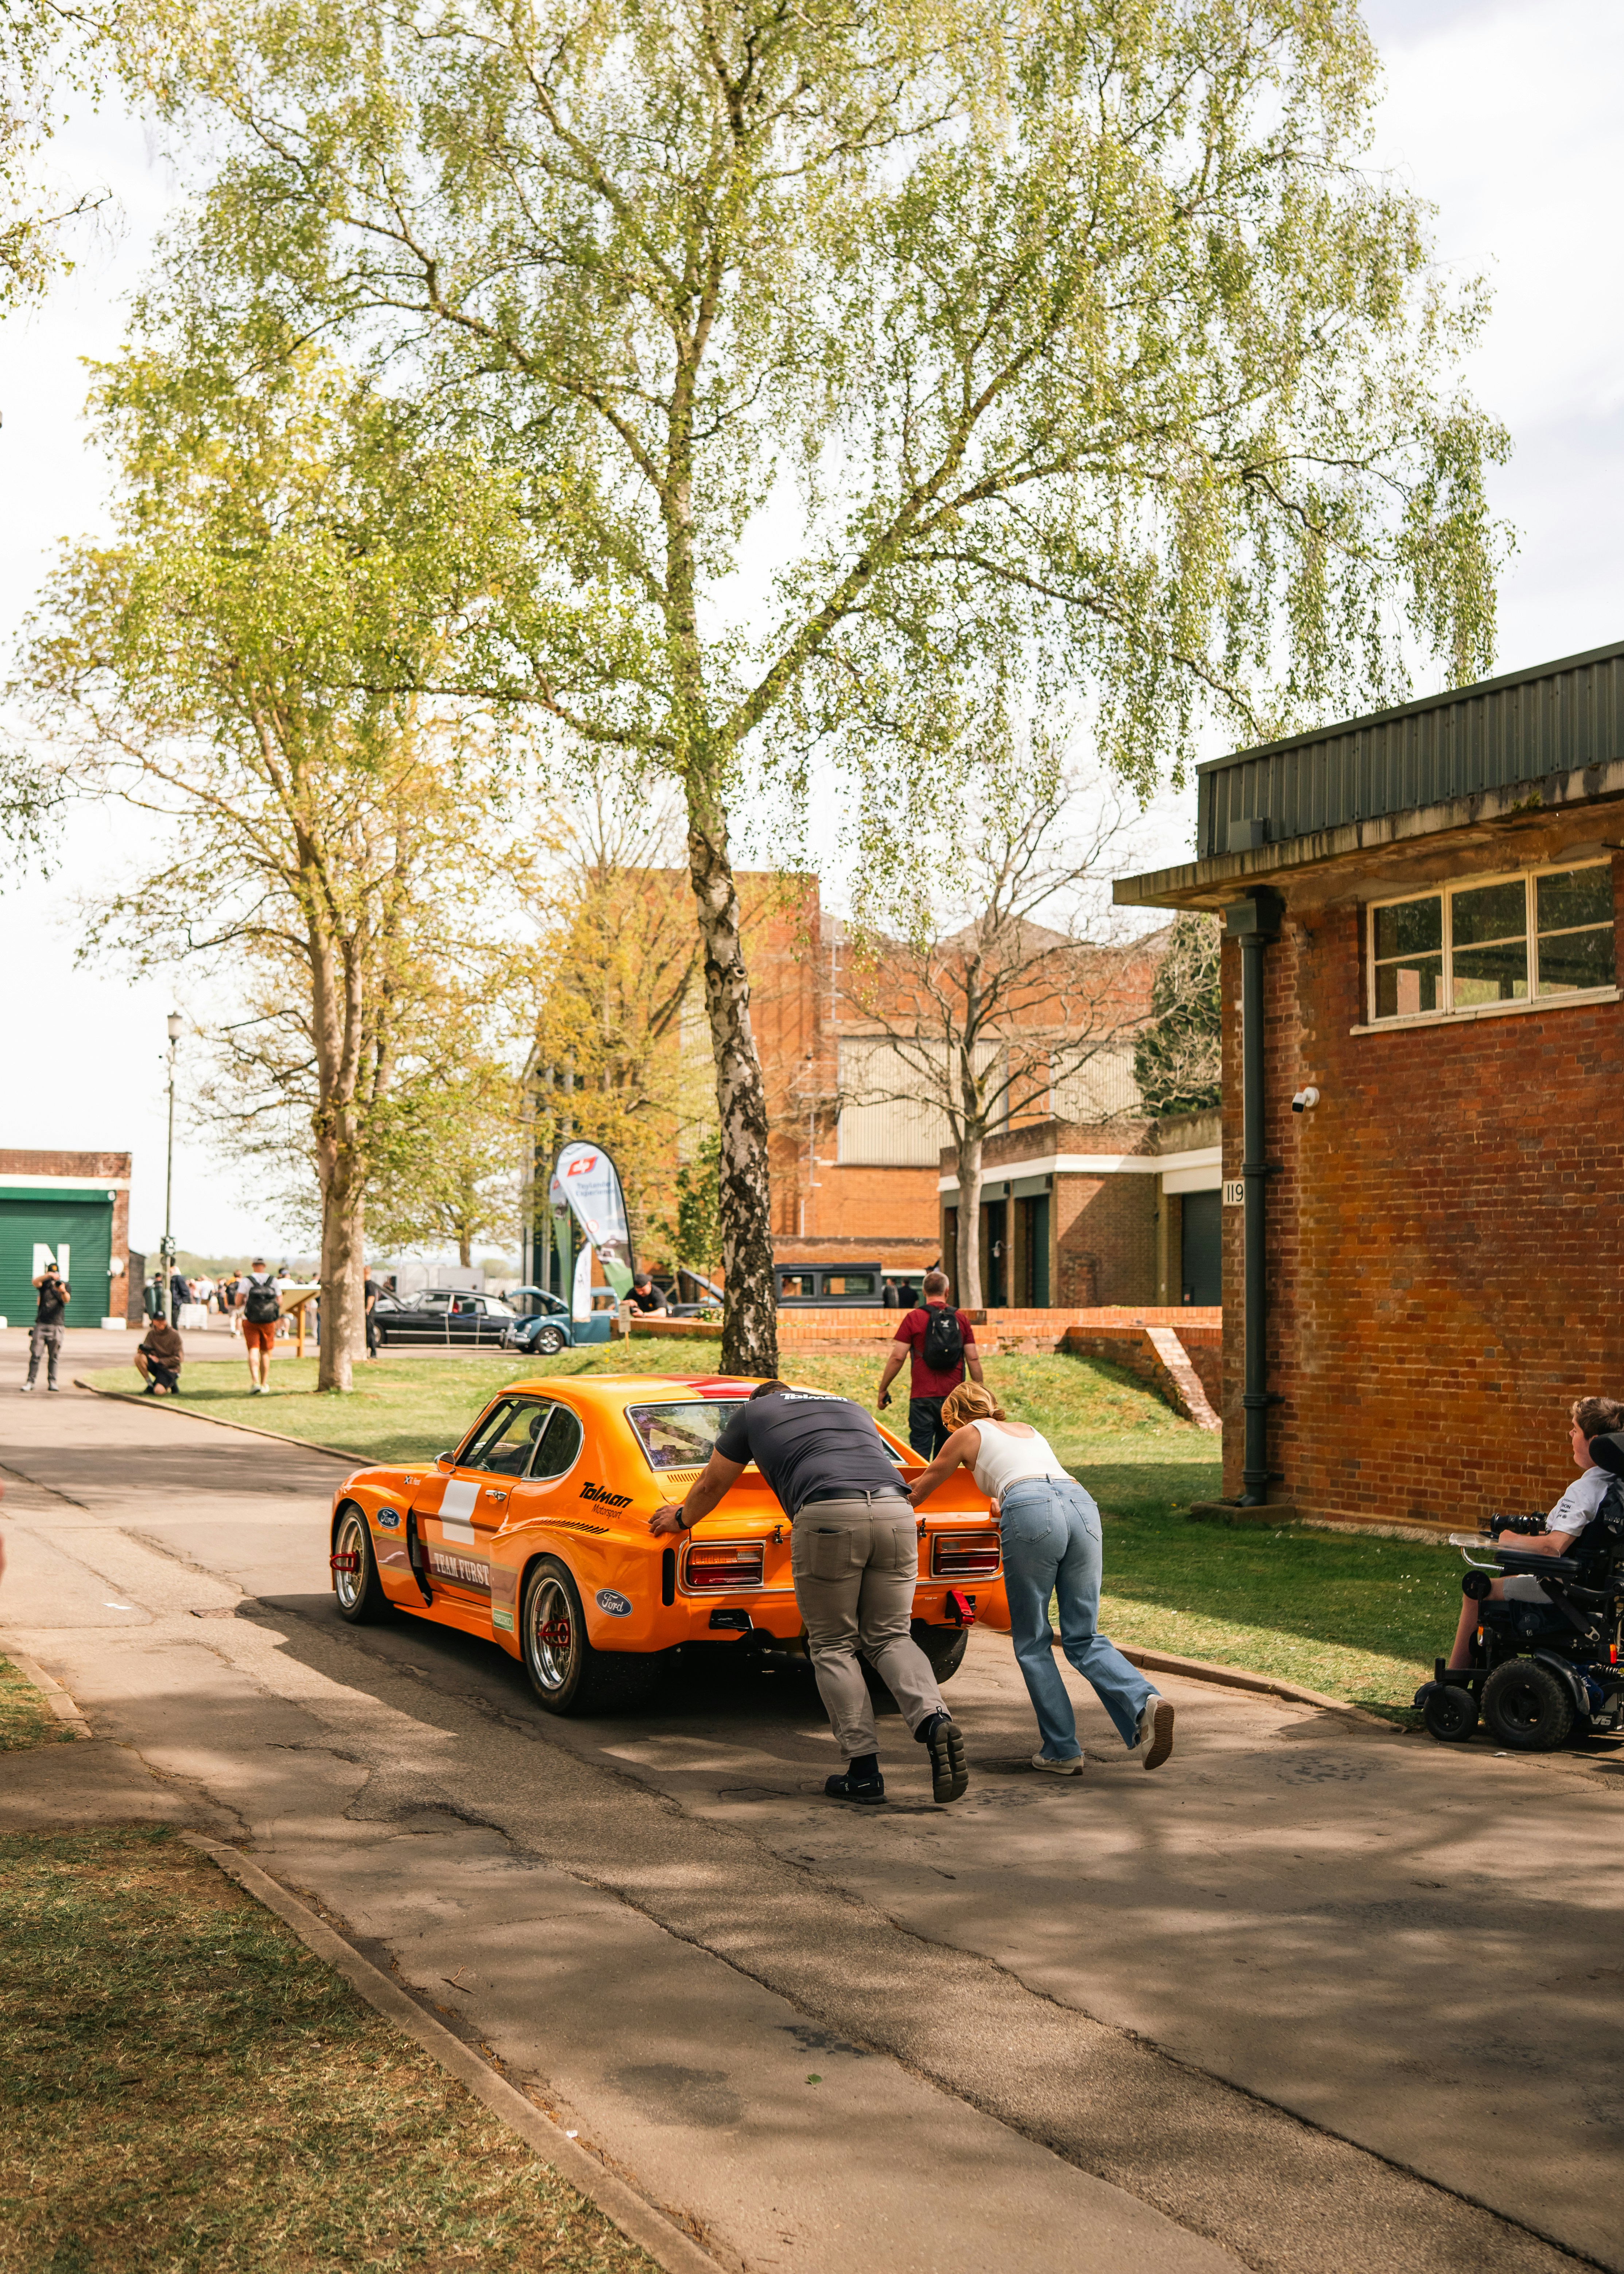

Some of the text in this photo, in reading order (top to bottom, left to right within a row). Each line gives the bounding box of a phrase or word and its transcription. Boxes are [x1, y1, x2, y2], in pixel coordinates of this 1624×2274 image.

[1228, 1184, 1244, 1202] 119
[32, 1243, 70, 1282] N
[780, 1393, 848, 1402] Tolman
[579, 1481, 634, 1508] Tolman
[380, 1509, 396, 1525] Ford
[591, 1503, 623, 1520] Motorsport
[434, 1552, 490, 1586] TEAM FURST
[602, 1593, 624, 1612] Ford
[494, 1613, 512, 1627] SEIKO
[1590, 1714, 1612, 1726] V6
